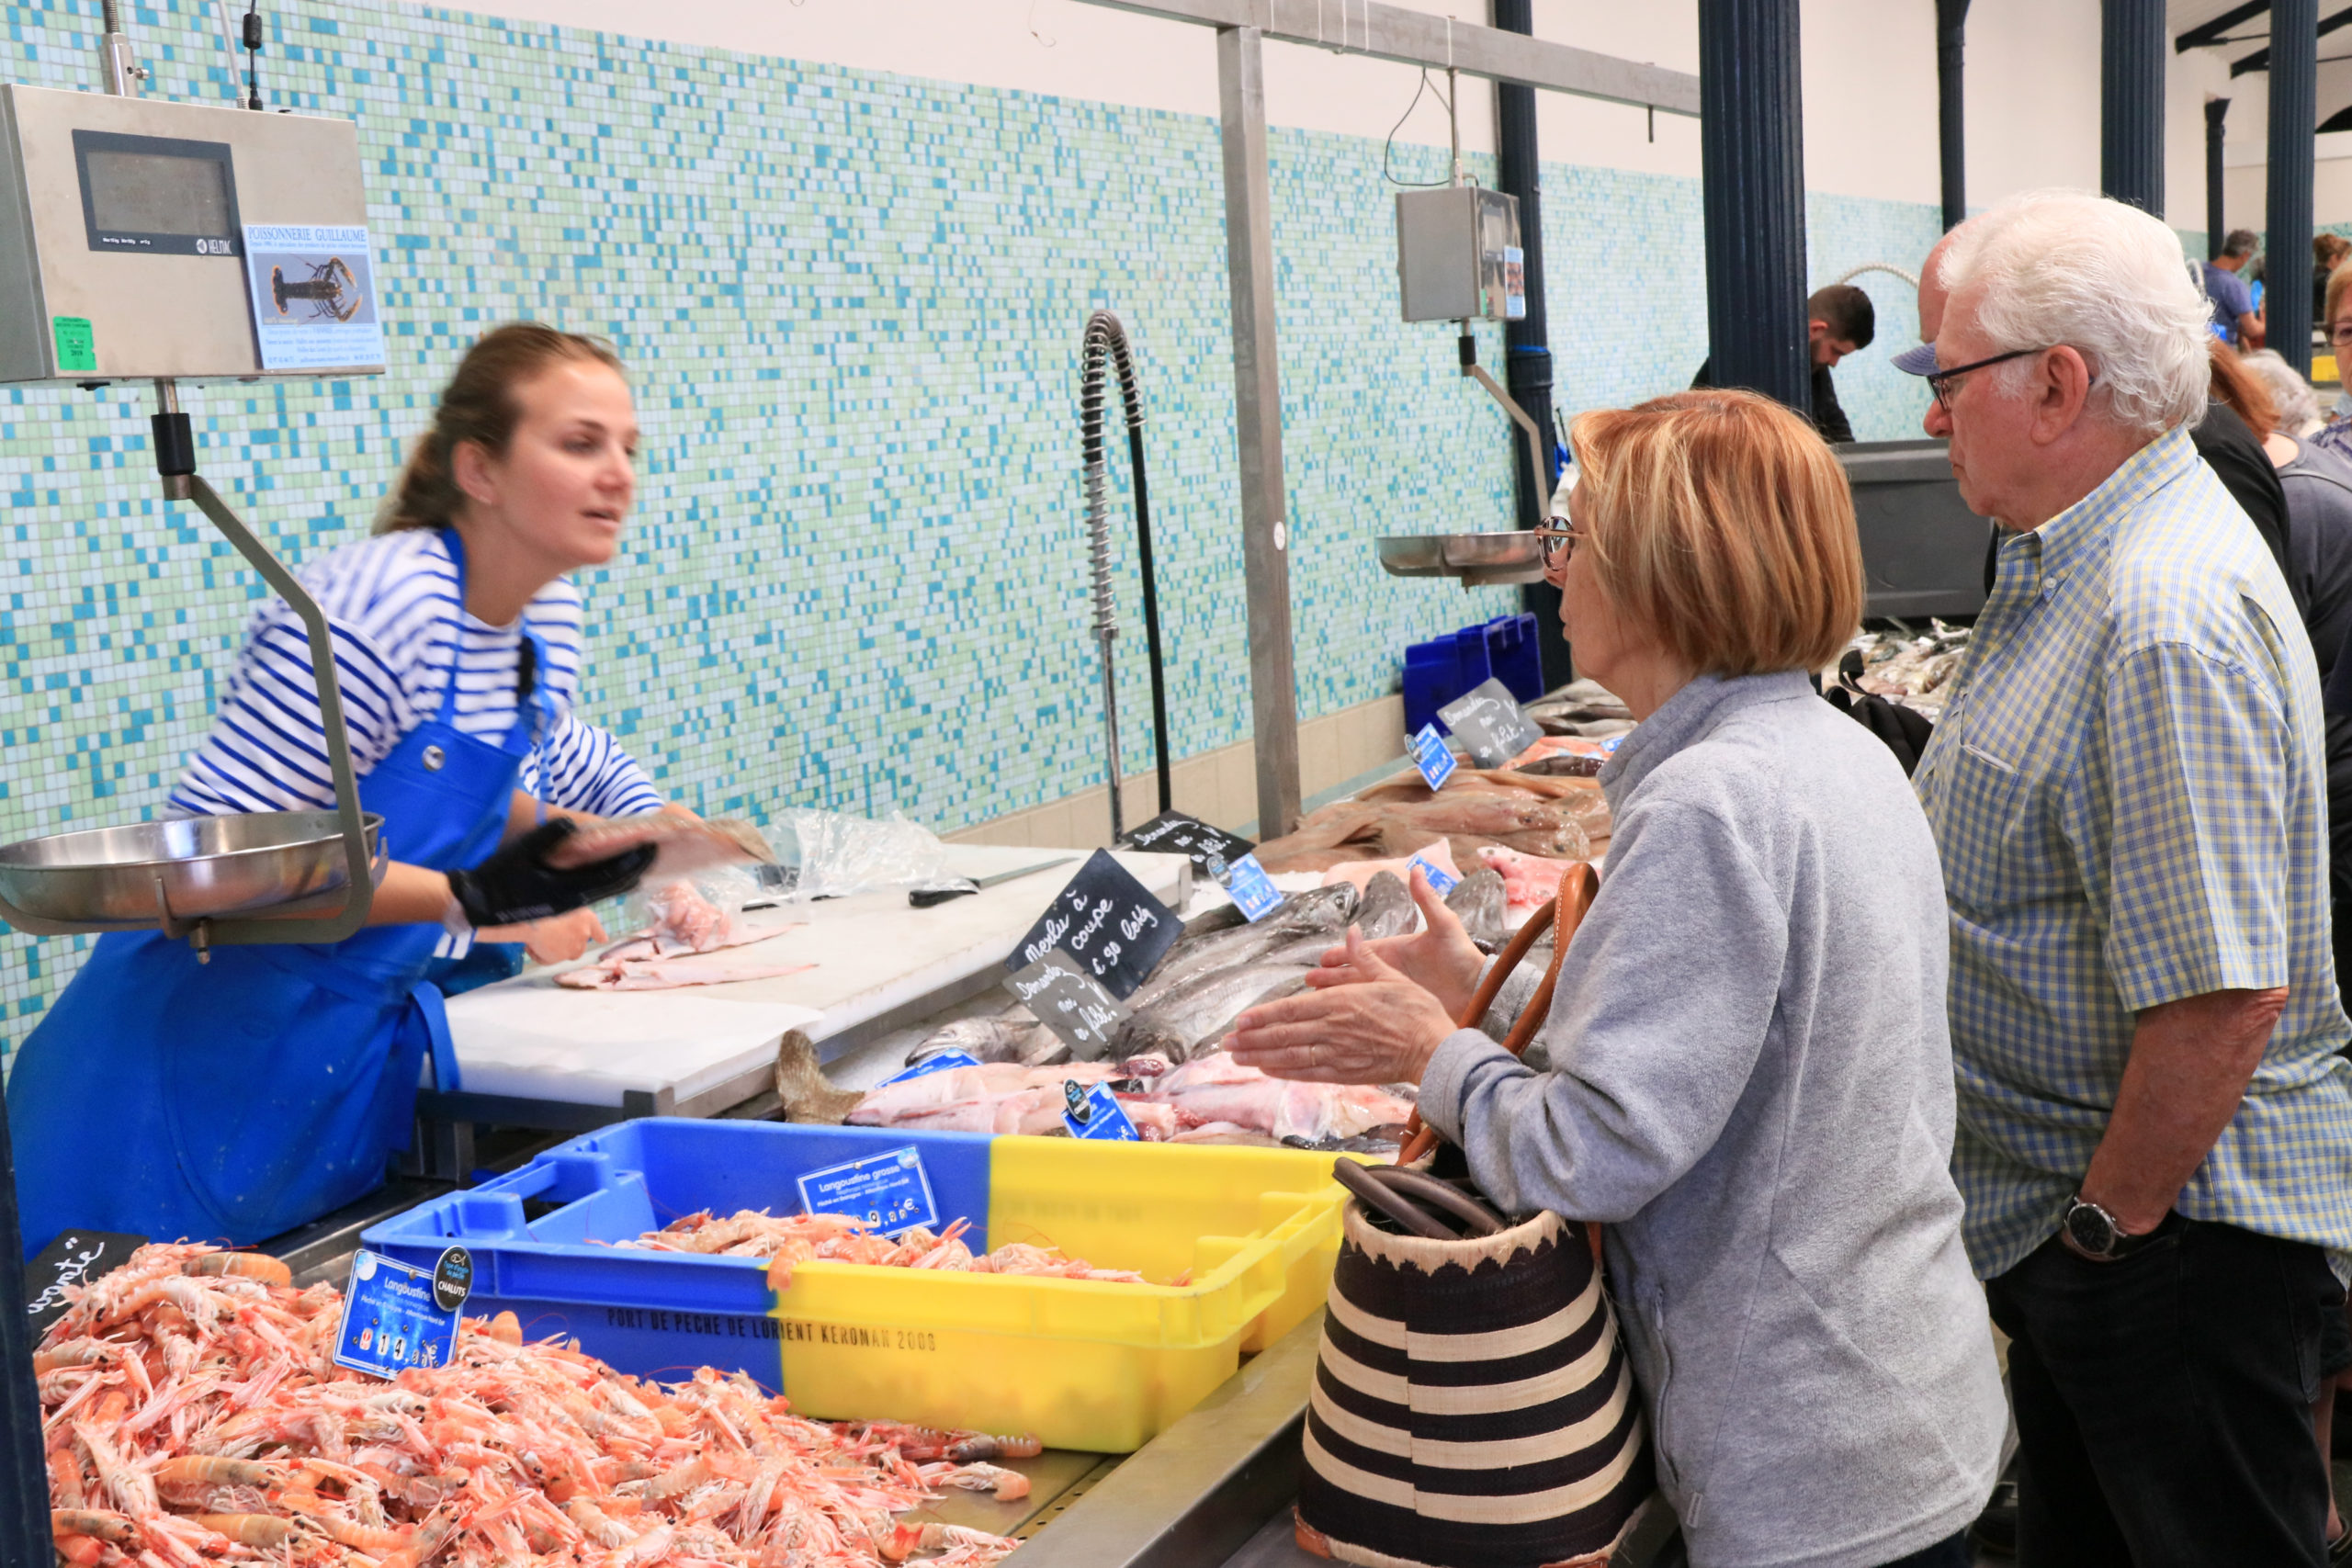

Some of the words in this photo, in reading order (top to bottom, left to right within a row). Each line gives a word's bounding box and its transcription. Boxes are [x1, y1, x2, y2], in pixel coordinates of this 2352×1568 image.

[248, 226, 311, 242] POISSONNERIE
[315, 228, 367, 242] GUILLAUME
[1071, 898, 1114, 950] coupe
[1024, 913, 1069, 964] Merlu
[819, 1171, 872, 1193] Langoustine
[872, 1165, 901, 1180] grosse
[384, 1276, 431, 1302] Langoustine
[437, 1280, 466, 1298] CHALUTS
[607, 1308, 642, 1328] PORT
[650, 1312, 668, 1331] DE
[673, 1314, 721, 1336] PECHE
[728, 1318, 745, 1337] DE
[752, 1319, 812, 1342] LORIENT
[820, 1325, 890, 1348] KEROMAN
